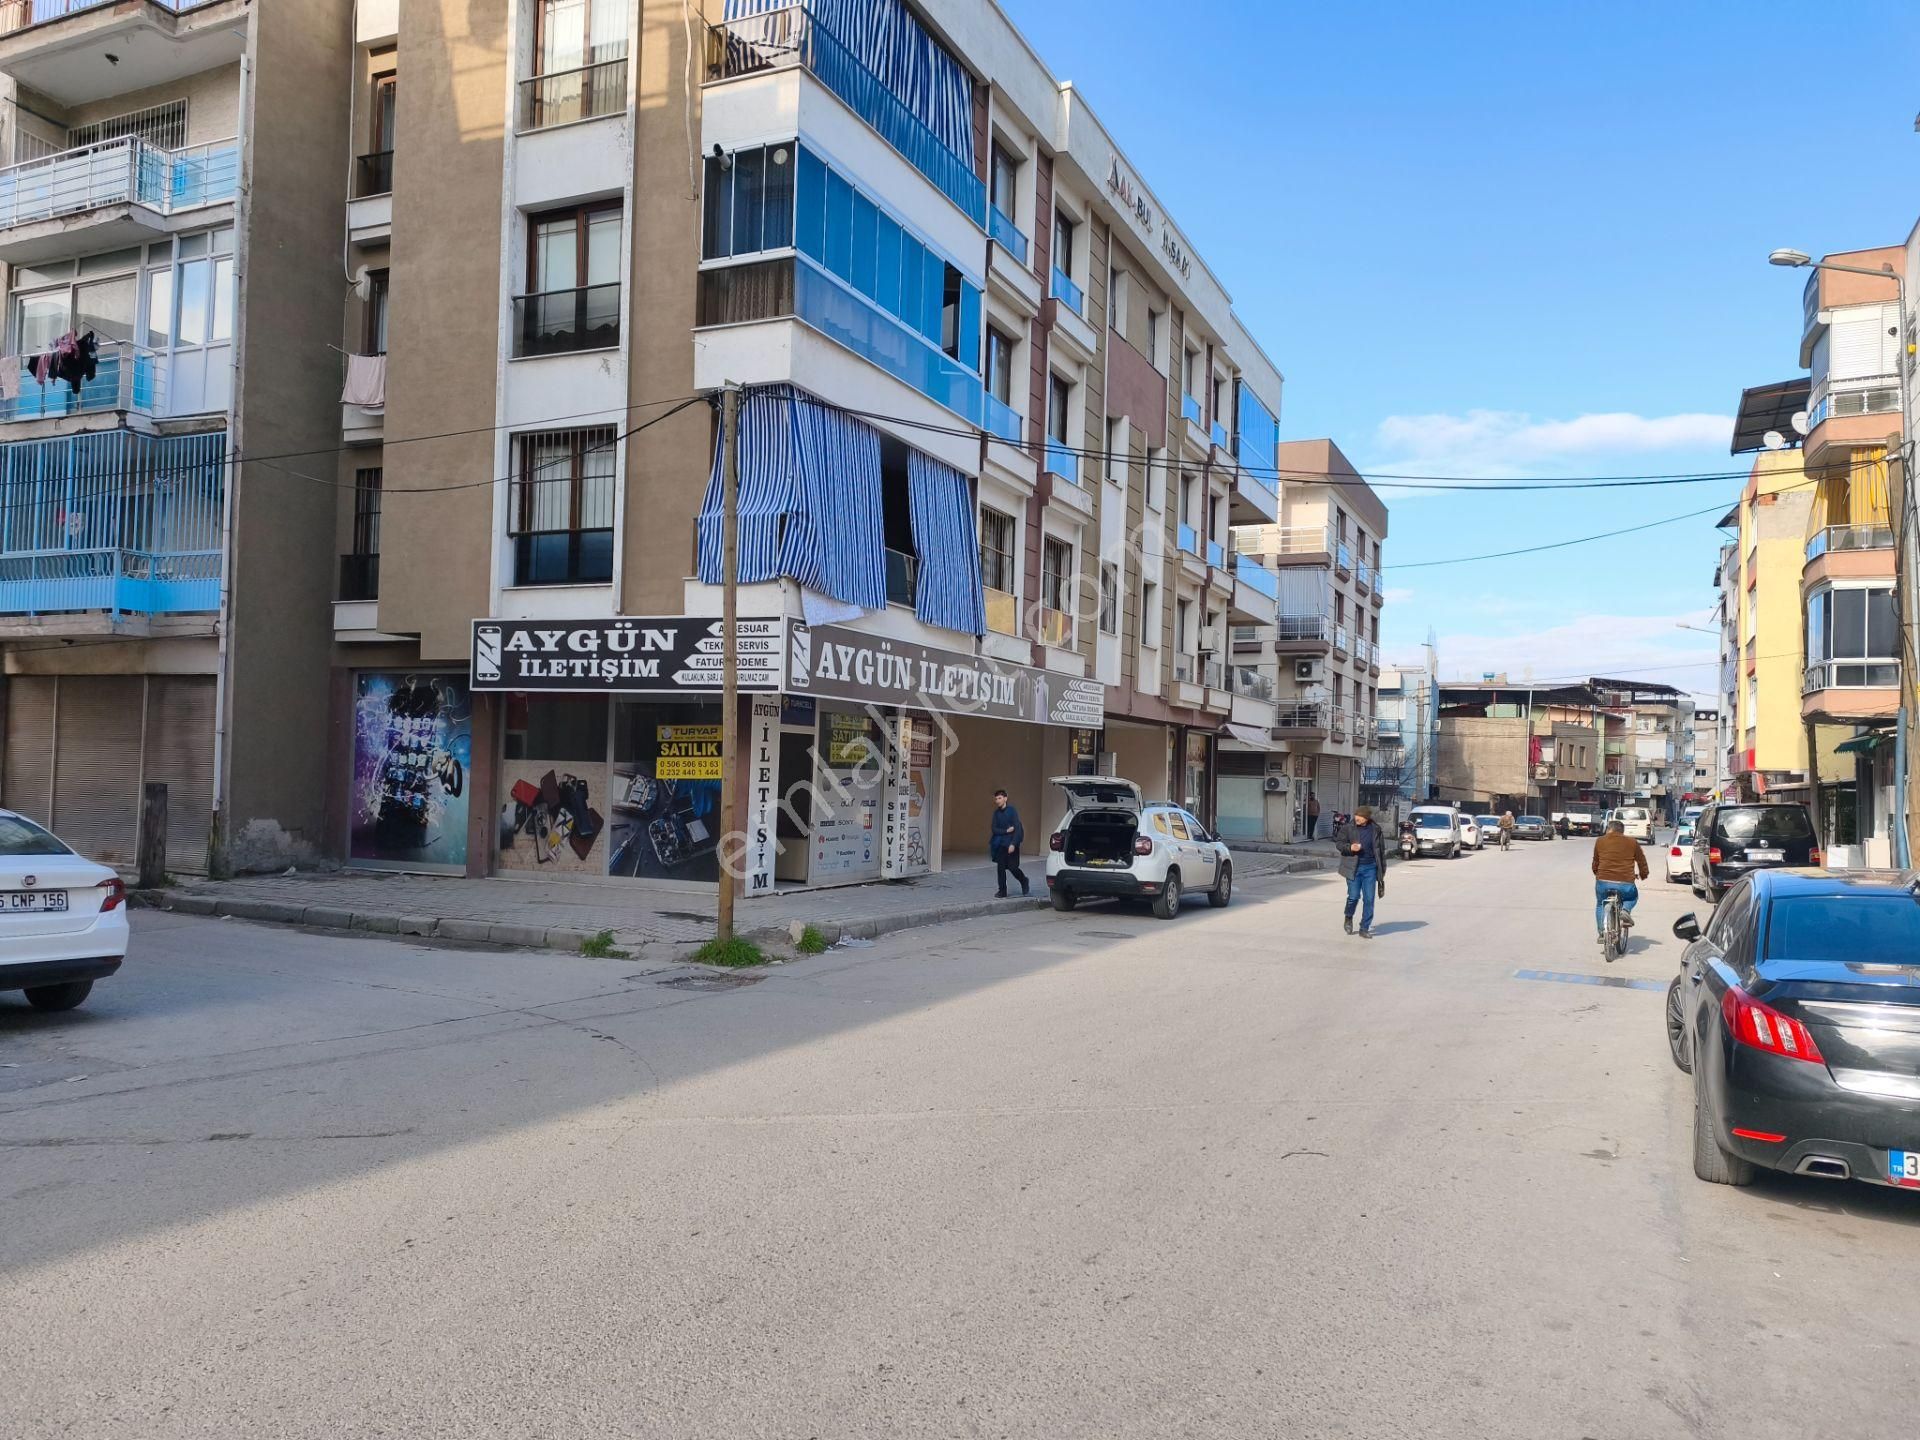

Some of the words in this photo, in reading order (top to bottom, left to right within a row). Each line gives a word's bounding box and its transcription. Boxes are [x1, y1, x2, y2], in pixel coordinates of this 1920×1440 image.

[504, 622, 678, 652] AYGÜN
[738, 640, 769, 650] SERVİS
[518, 653, 660, 683] İLETİŞİM
[696, 658, 723, 667] FATUR
[816, 641, 912, 691] AYGÜN
[919, 650, 1015, 711] İLETİŞİM
[754, 701, 780, 718] AYGÜN
[660, 742, 718, 756] SATILIK
[660, 760, 664, 768] 0
[667, 760, 680, 768] 506
[682, 760, 695, 768] 506
[710, 760, 718, 768] 63
[885, 801, 895, 869] SERVİS
[12, 894, 35, 908] CNP
[43, 894, 64, 907] 156
[1893, 1164, 1903, 1173] TR
[1906, 1155, 1919, 1176] 3
